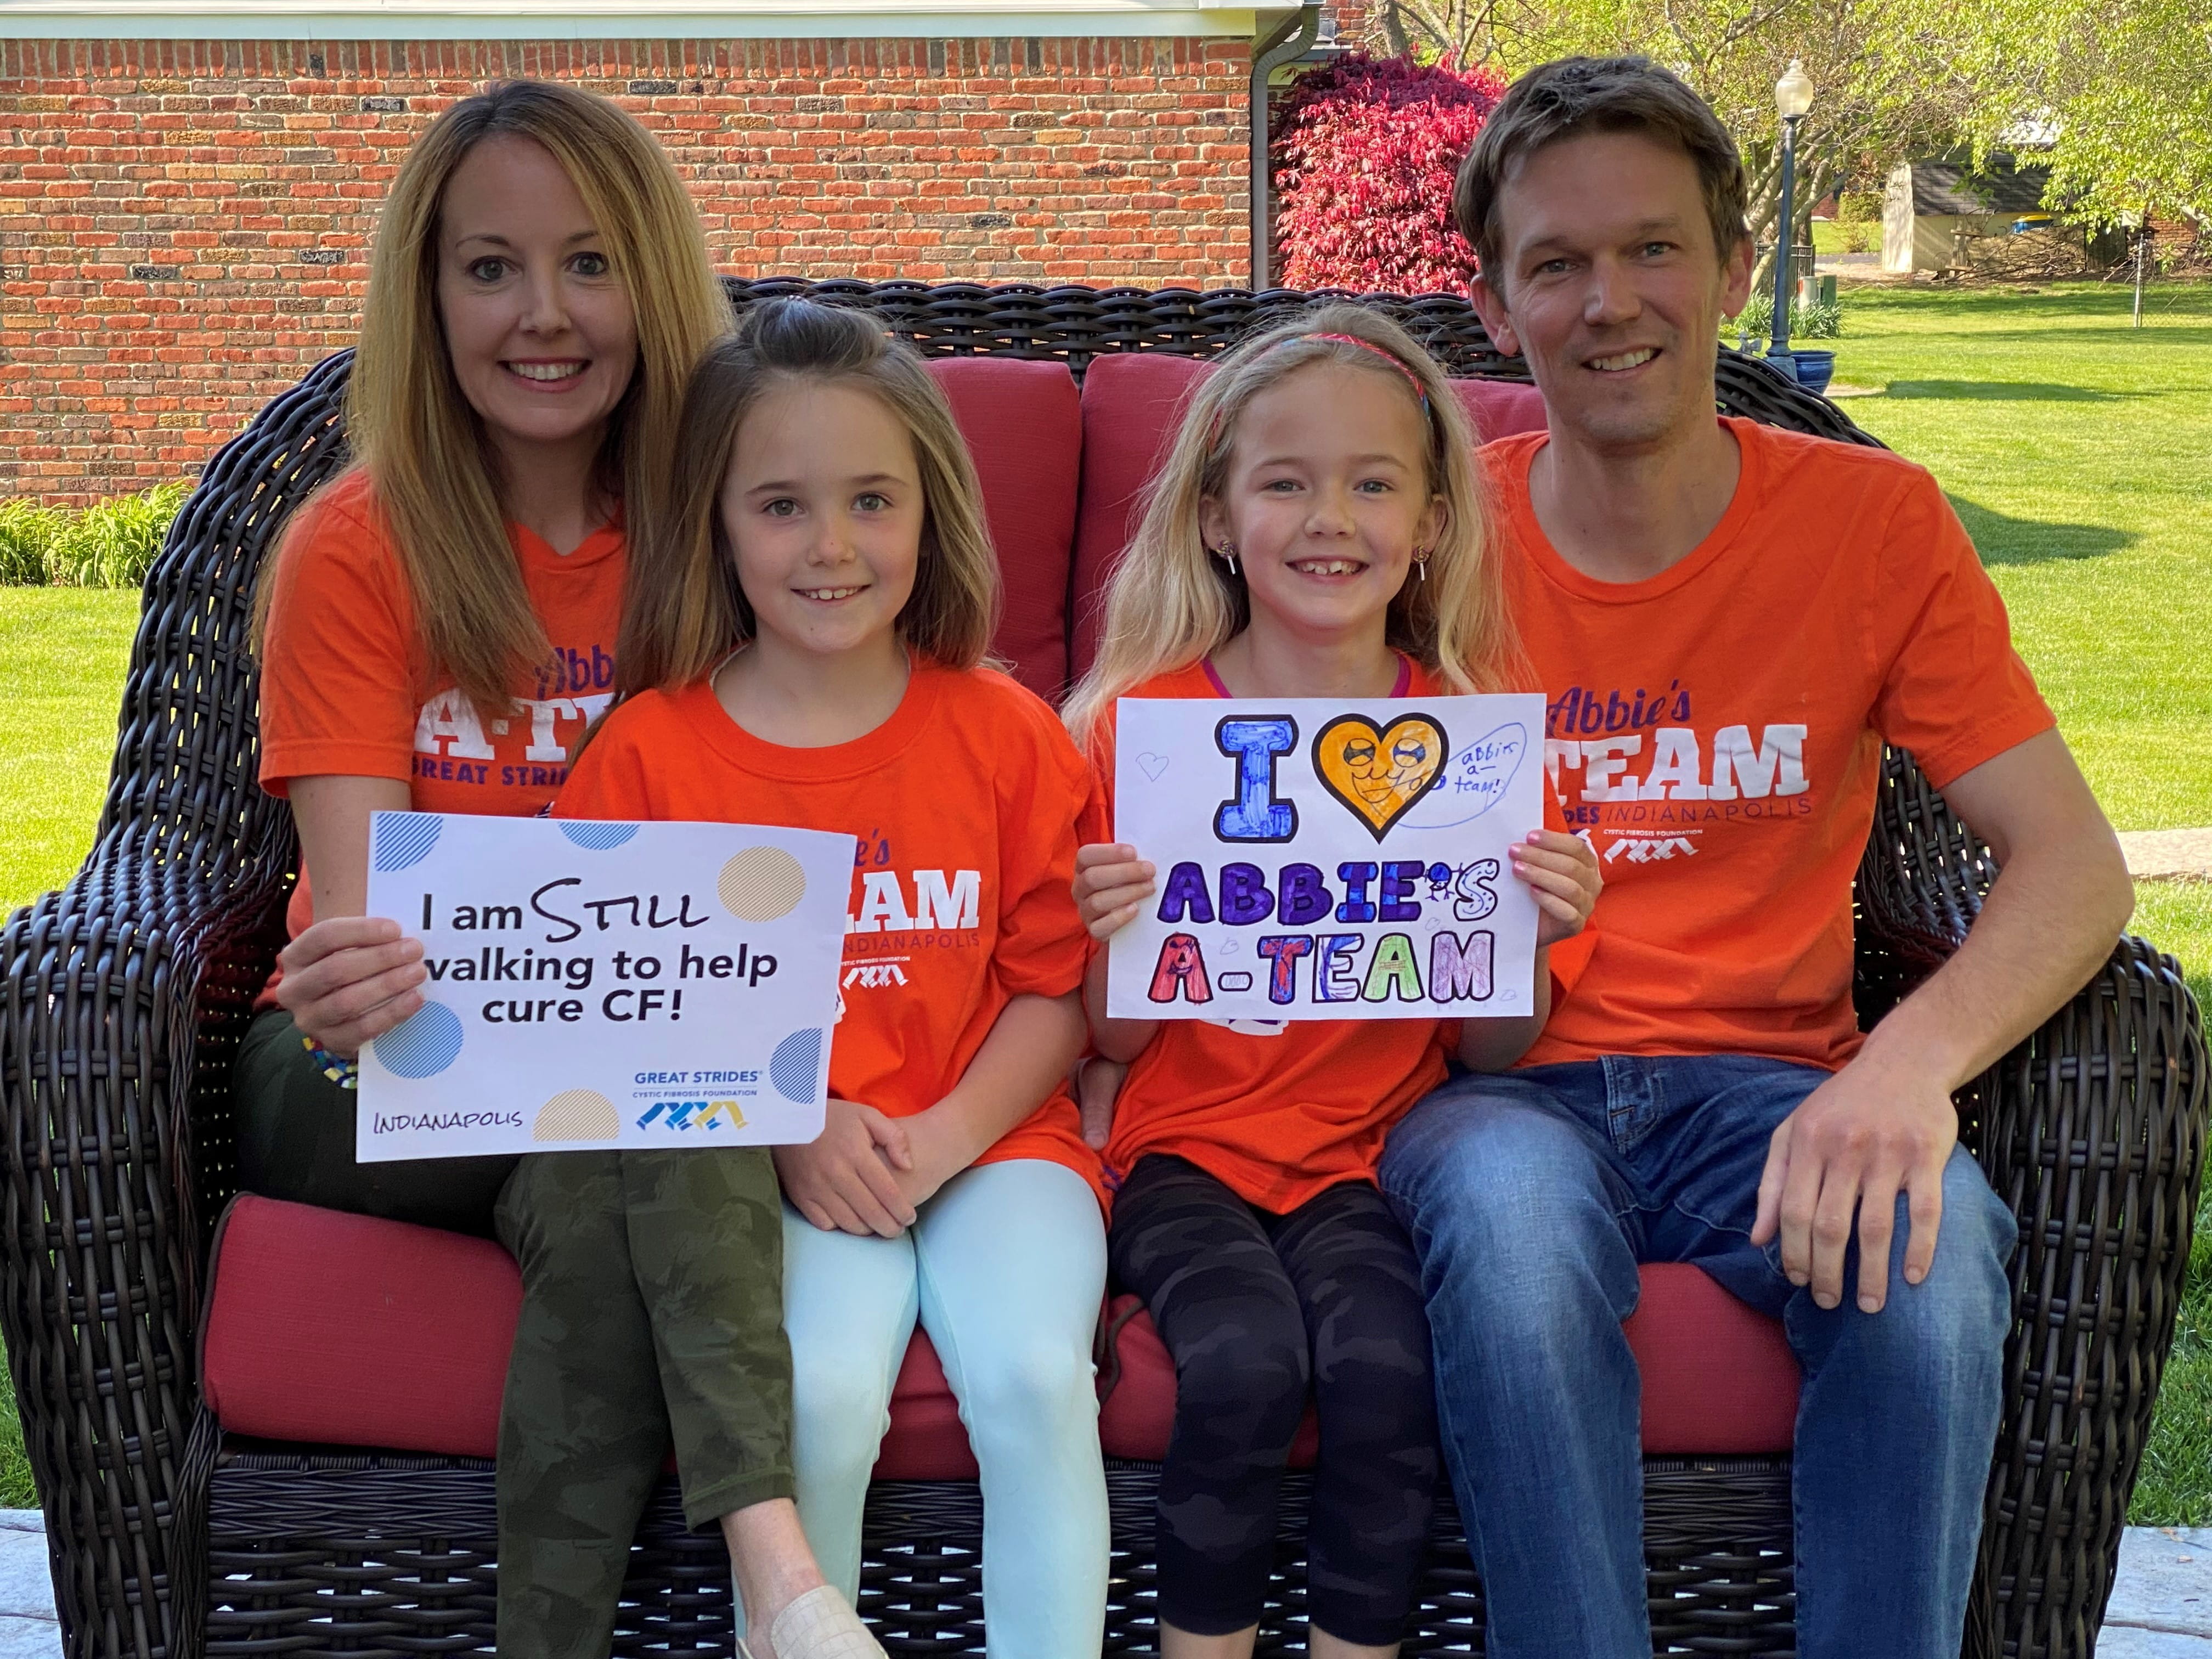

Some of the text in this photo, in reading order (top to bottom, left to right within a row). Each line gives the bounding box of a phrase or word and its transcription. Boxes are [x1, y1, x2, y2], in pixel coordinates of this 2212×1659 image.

[1546, 679, 1690, 739] Abbie's
[1213, 714, 1299, 843] I
[1607, 798, 1812, 822] INDIANAPOLIS
[422, 877, 711, 943] I am STILL
[1157, 858, 1500, 926] ABBIE'S
[613, 952, 661, 980] to
[680, 943, 778, 987] help
[1148, 930, 1494, 1004] A-TEAM
[482, 989, 681, 1023] cure CF!
[635, 1072, 689, 1084] GREAT
[703, 1089, 758, 1097] FOUNDATION
[374, 1111, 523, 1134] INDIANAPOLIS
